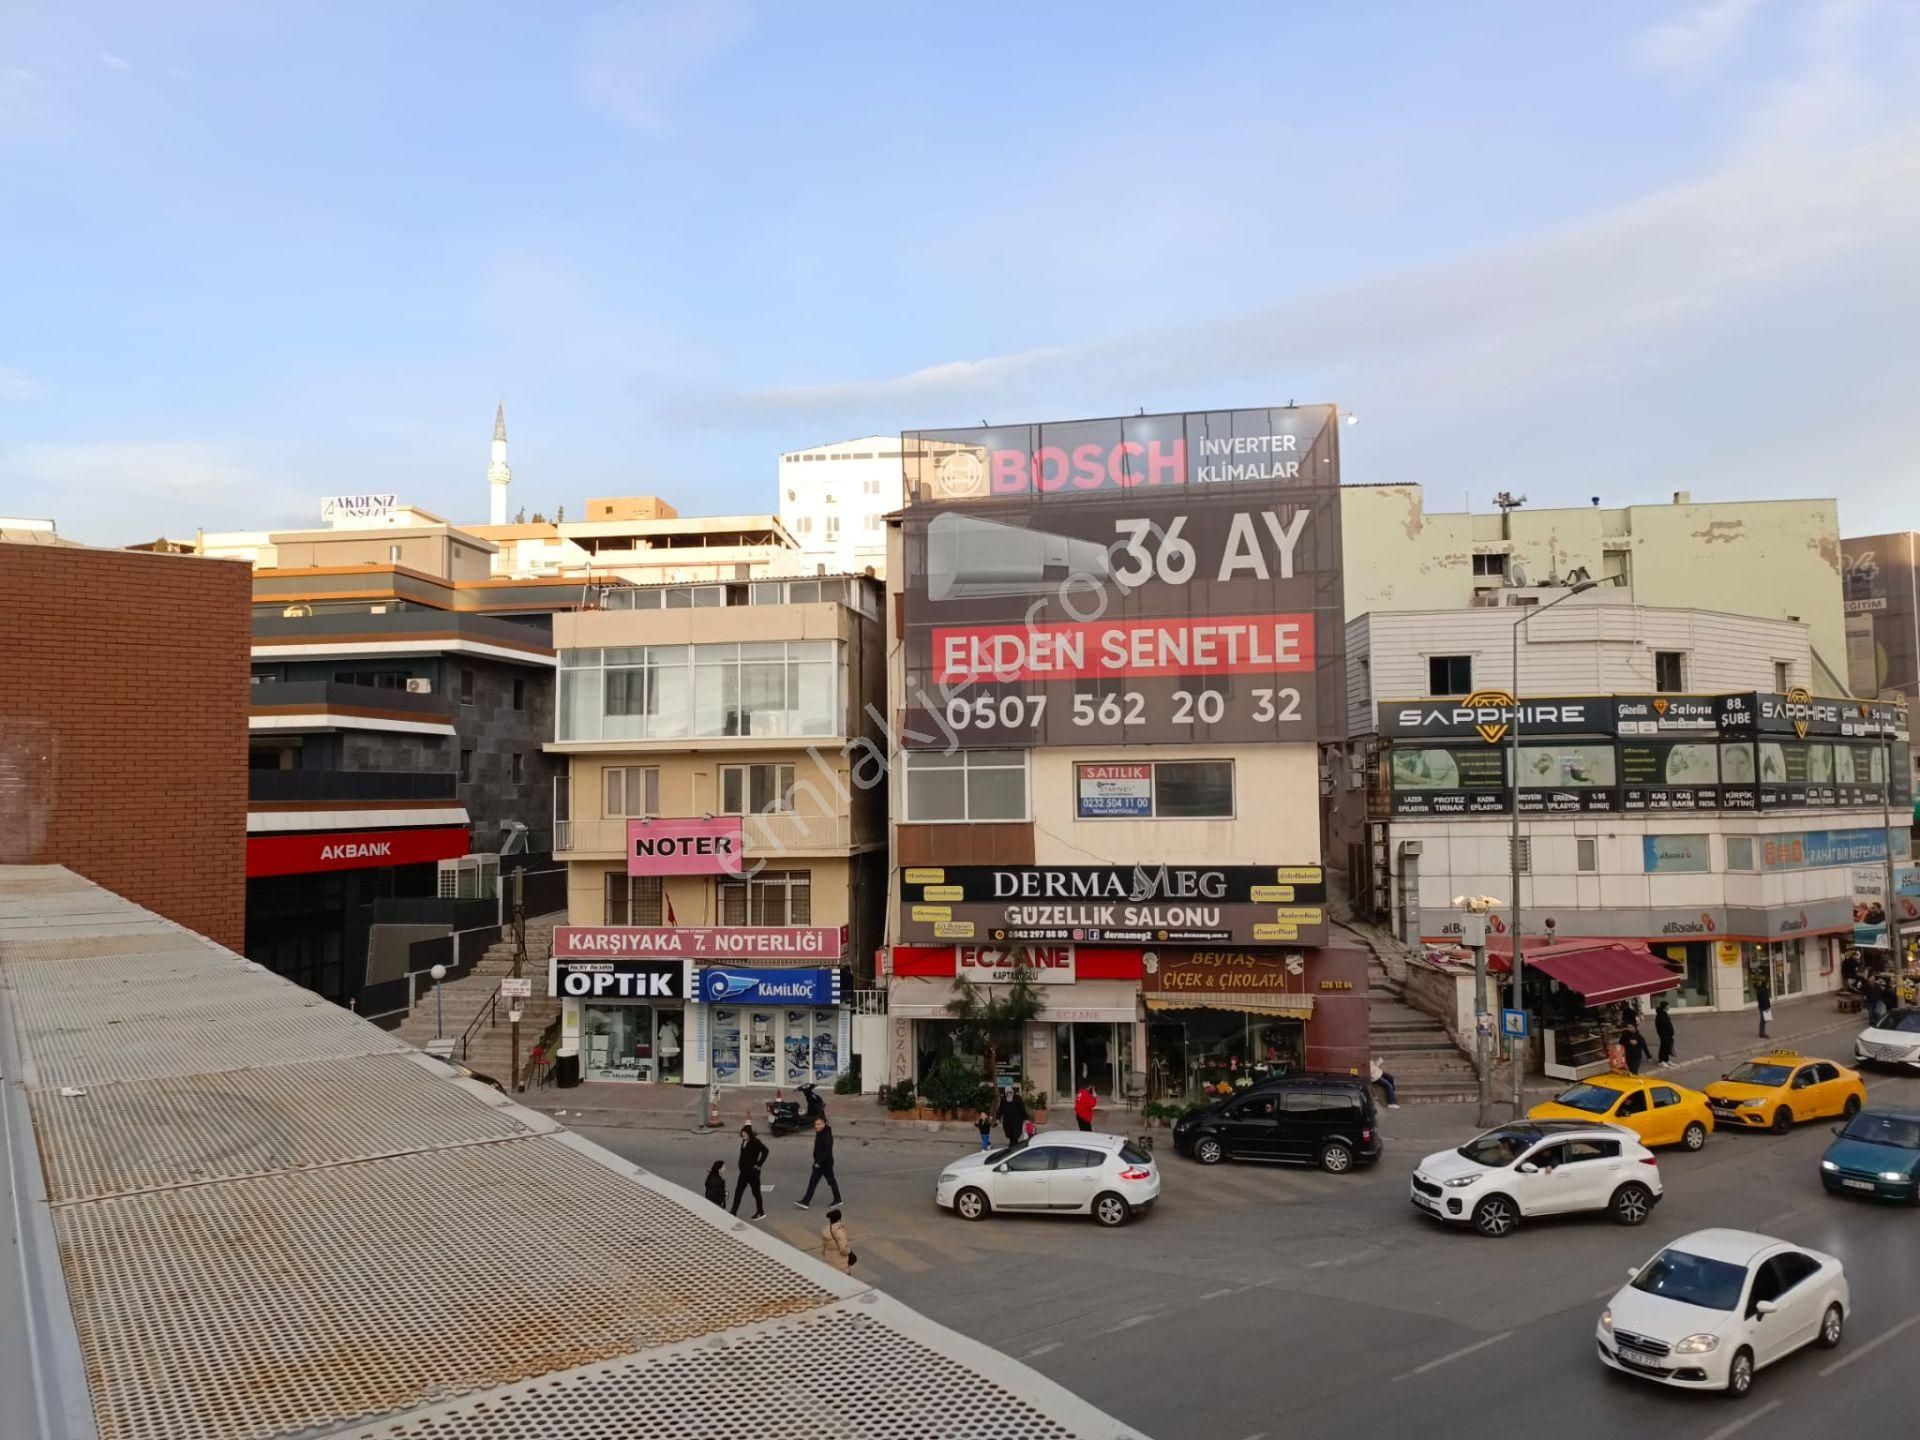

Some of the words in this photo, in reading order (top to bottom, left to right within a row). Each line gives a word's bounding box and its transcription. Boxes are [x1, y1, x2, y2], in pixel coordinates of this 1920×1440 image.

[1200, 434, 1297, 457] İNVERTER
[991, 439, 1187, 492] BOSCH
[1197, 460, 1300, 484] KLİMALAR
[1115, 515, 1197, 588] 36
[1217, 509, 1311, 583] AY
[945, 630, 1085, 675] ELDEN
[1101, 623, 1300, 669] SENETLE
[946, 695, 1048, 731] 0507
[1072, 692, 1146, 726] 562
[1171, 690, 1225, 724] 20
[1251, 688, 1302, 722] 32
[1618, 703, 1648, 718] Güzellik
[1669, 703, 1712, 715] Salonu
[1726, 698, 1746, 710] 88.
[1761, 702, 1838, 722] SAPPHIRE
[1399, 707, 1585, 727] SAPPHIRE
[1721, 712, 1751, 727] ŞUBE
[1087, 767, 1143, 778] SATILIK
[1083, 799, 1105, 808] 0232
[1106, 799, 1122, 808] 504
[1137, 799, 1149, 808] 00
[1433, 796, 1465, 804] PROTEZ
[1651, 792, 1667, 801] KAŞ
[1676, 792, 1692, 801] KAŞ
[1725, 791, 1753, 799] KİRPİK
[320, 842, 391, 860] AKBANK
[635, 836, 732, 856] NOTER
[1004, 906, 1115, 926] GÜZELLİK
[1124, 907, 1220, 927] SALONU
[1029, 930, 1045, 939] 297
[1104, 930, 1152, 941] dermameg2
[1662, 921, 1704, 933] alBaraka
[568, 933, 682, 954] KARŞIYAKA
[693, 935, 706, 950] 7.
[715, 931, 823, 951] NOTERLİĞİ
[960, 946, 1070, 968] ECZANE
[1163, 972, 1202, 990] ÇİÇEK
[1206, 975, 1215, 987] &
[1219, 971, 1285, 990] ÇİKOLATA
[896, 1019, 906, 1082] ECZAN
